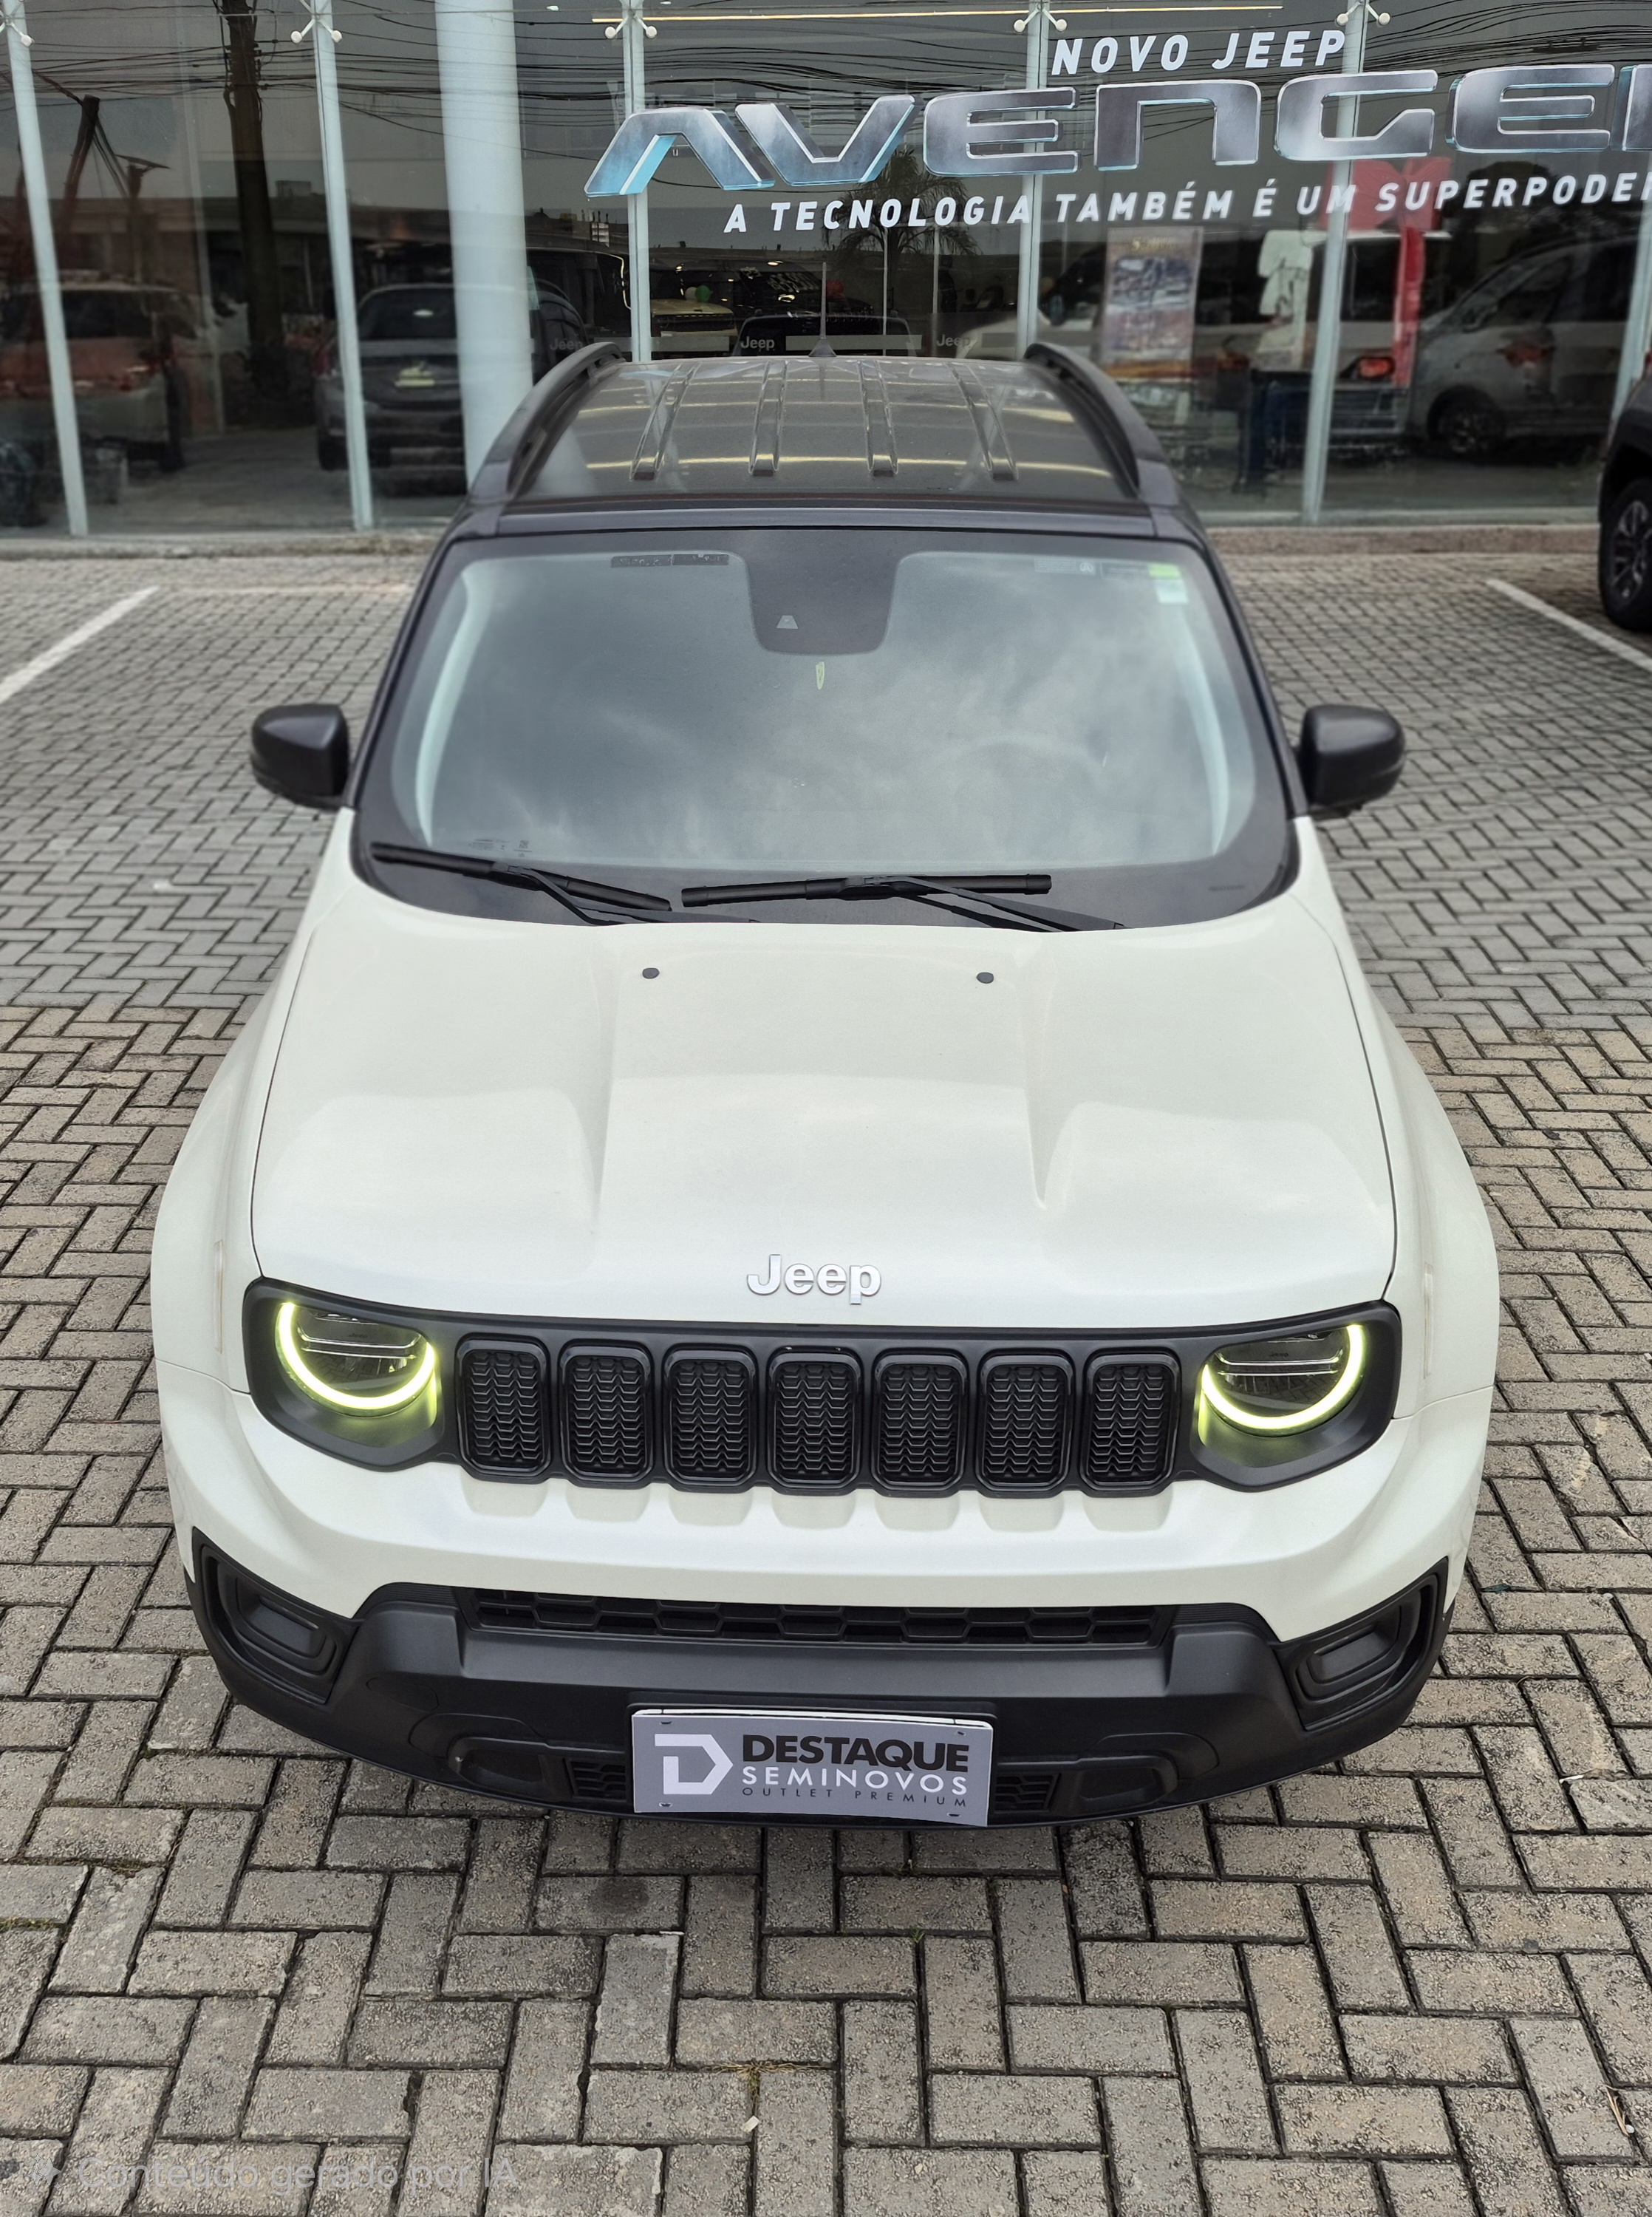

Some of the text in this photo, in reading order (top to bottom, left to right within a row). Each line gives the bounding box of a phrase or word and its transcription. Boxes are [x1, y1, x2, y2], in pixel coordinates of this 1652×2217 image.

[1051, 30, 1347, 75] NOVO JEEP
[723, 203, 747, 234] A
[771, 194, 1031, 231] TECNOLOGIA
[1056, 182, 1233, 222] TAMBÉM
[1252, 178, 1277, 217] É
[1296, 184, 1356, 216] UM
[740, 336, 775, 351] Jeep
[936, 334, 971, 348] Jeep
[747, 1254, 881, 1305] Jeep
[743, 1734, 969, 1772] DESTAQUE
[742, 1765, 967, 1795] SEMINOVOS
[742, 1787, 966, 1807] OUTLET PREMIUM
